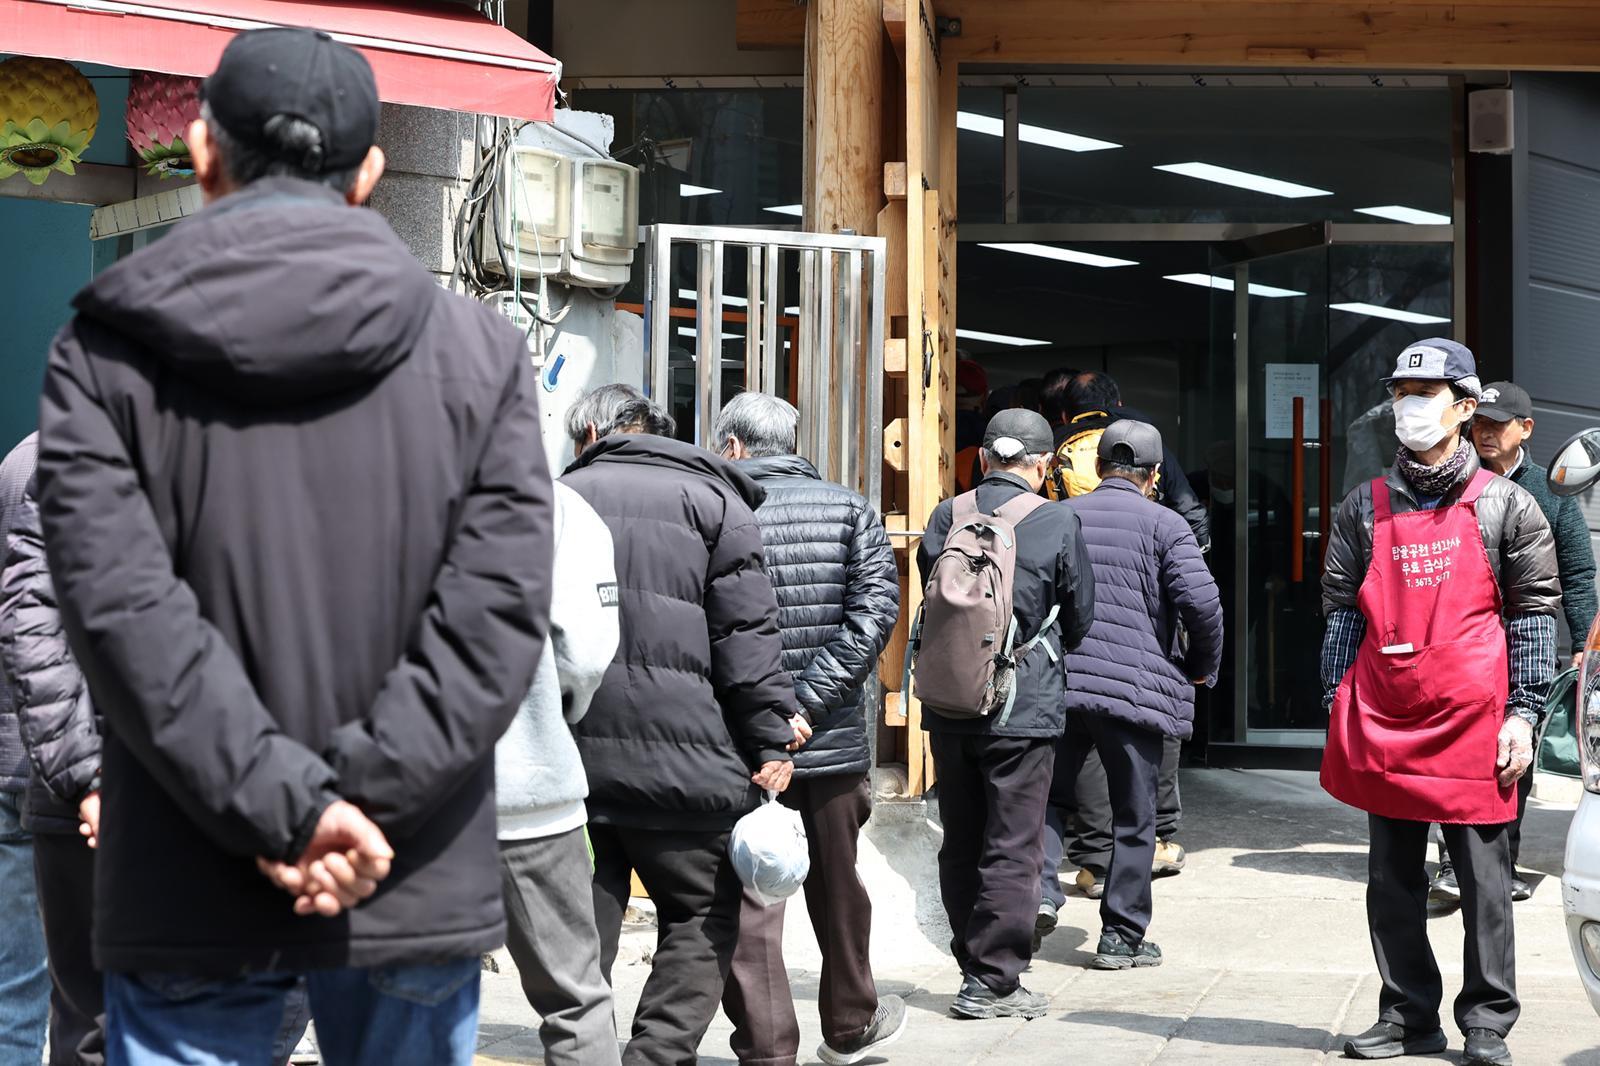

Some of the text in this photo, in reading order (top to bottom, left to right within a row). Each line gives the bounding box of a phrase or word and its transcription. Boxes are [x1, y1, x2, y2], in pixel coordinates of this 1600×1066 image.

[1391, 536, 1461, 560] 탑골공원 원각사
[1402, 555, 1451, 576] 무료 급식소
